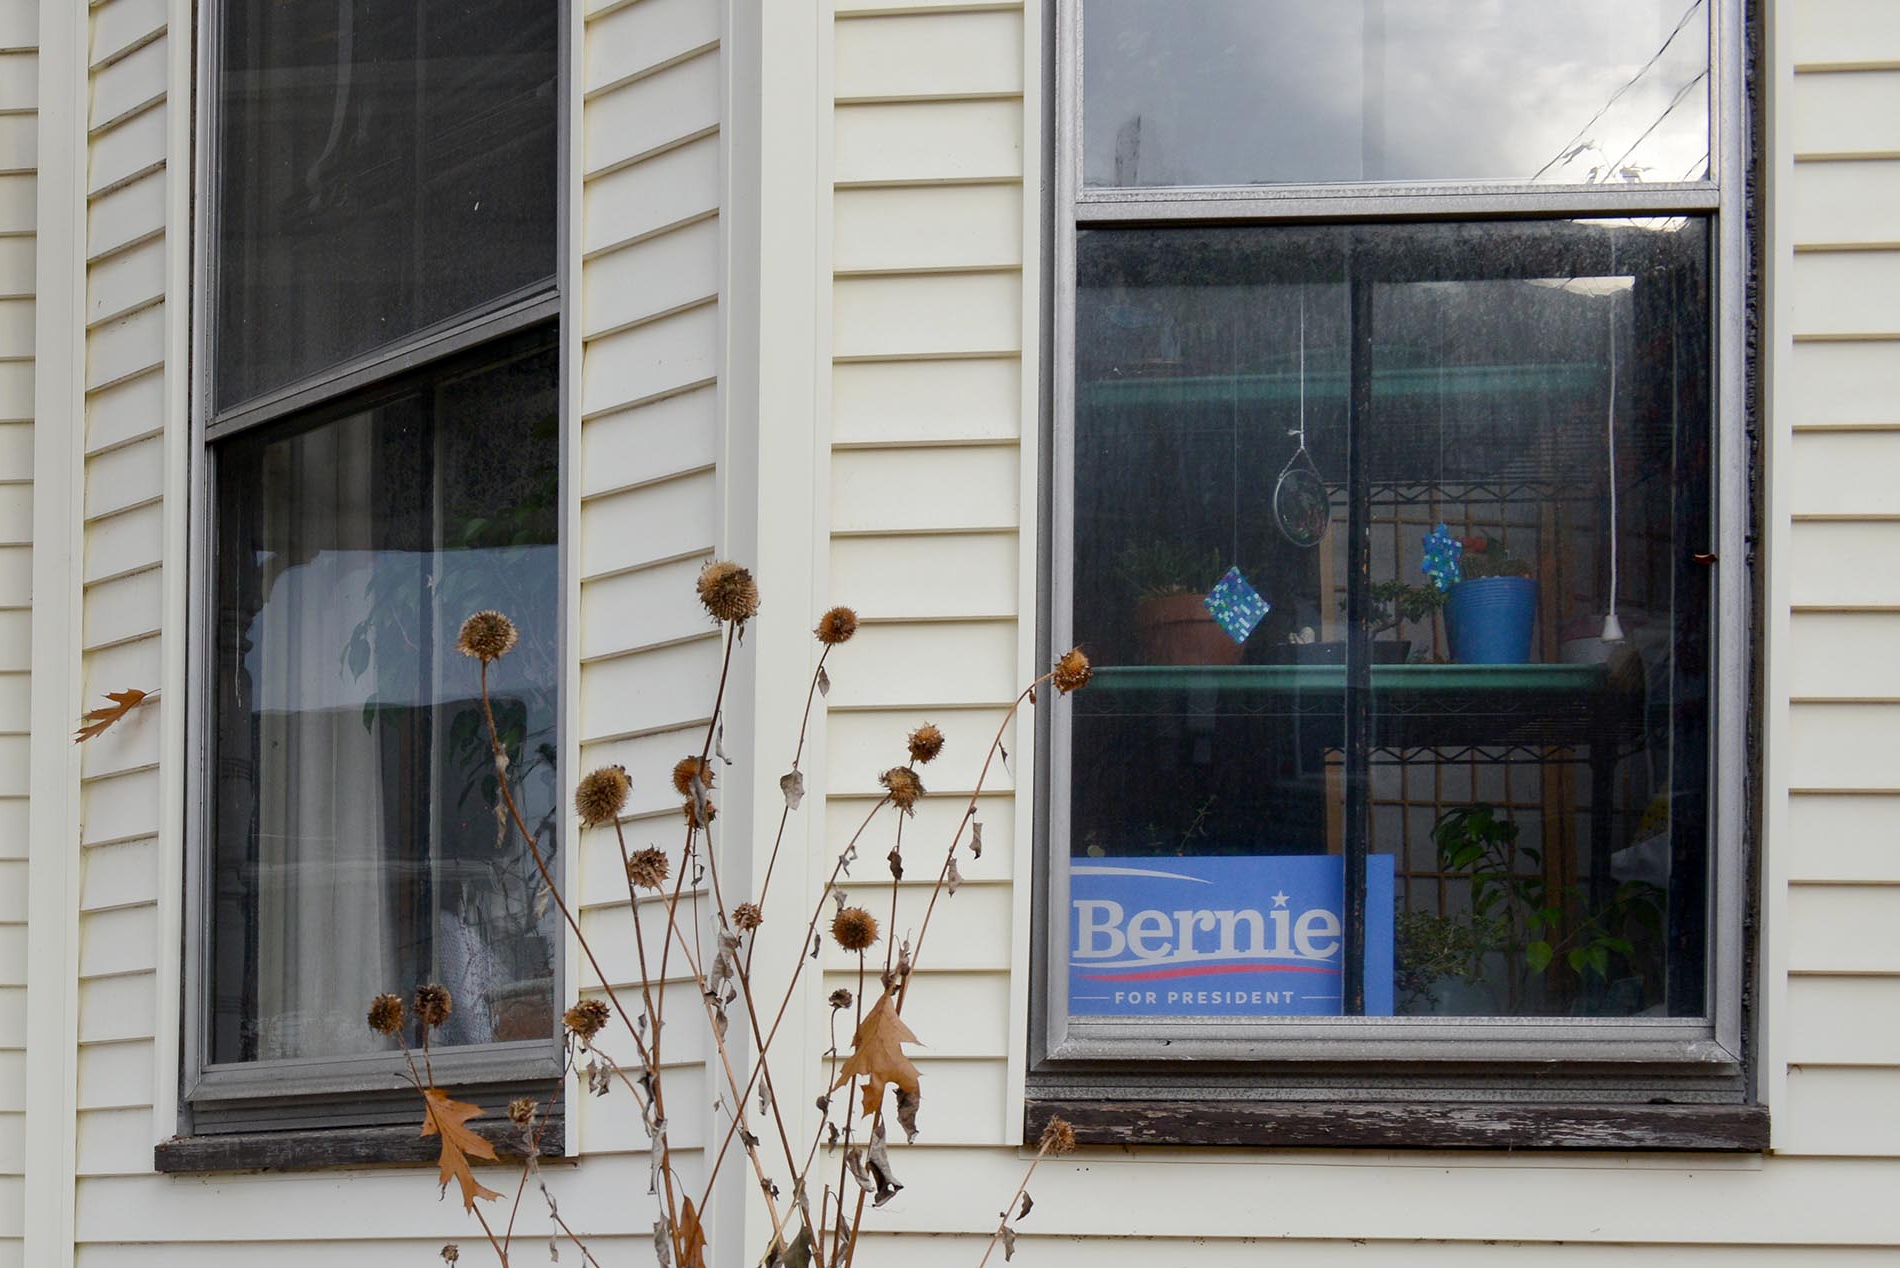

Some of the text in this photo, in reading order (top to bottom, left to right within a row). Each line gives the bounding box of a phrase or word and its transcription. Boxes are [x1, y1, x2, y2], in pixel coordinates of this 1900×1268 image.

[1072, 889, 1341, 960] Bernie
[1114, 991, 1295, 1005] FOR PRESIDENT
